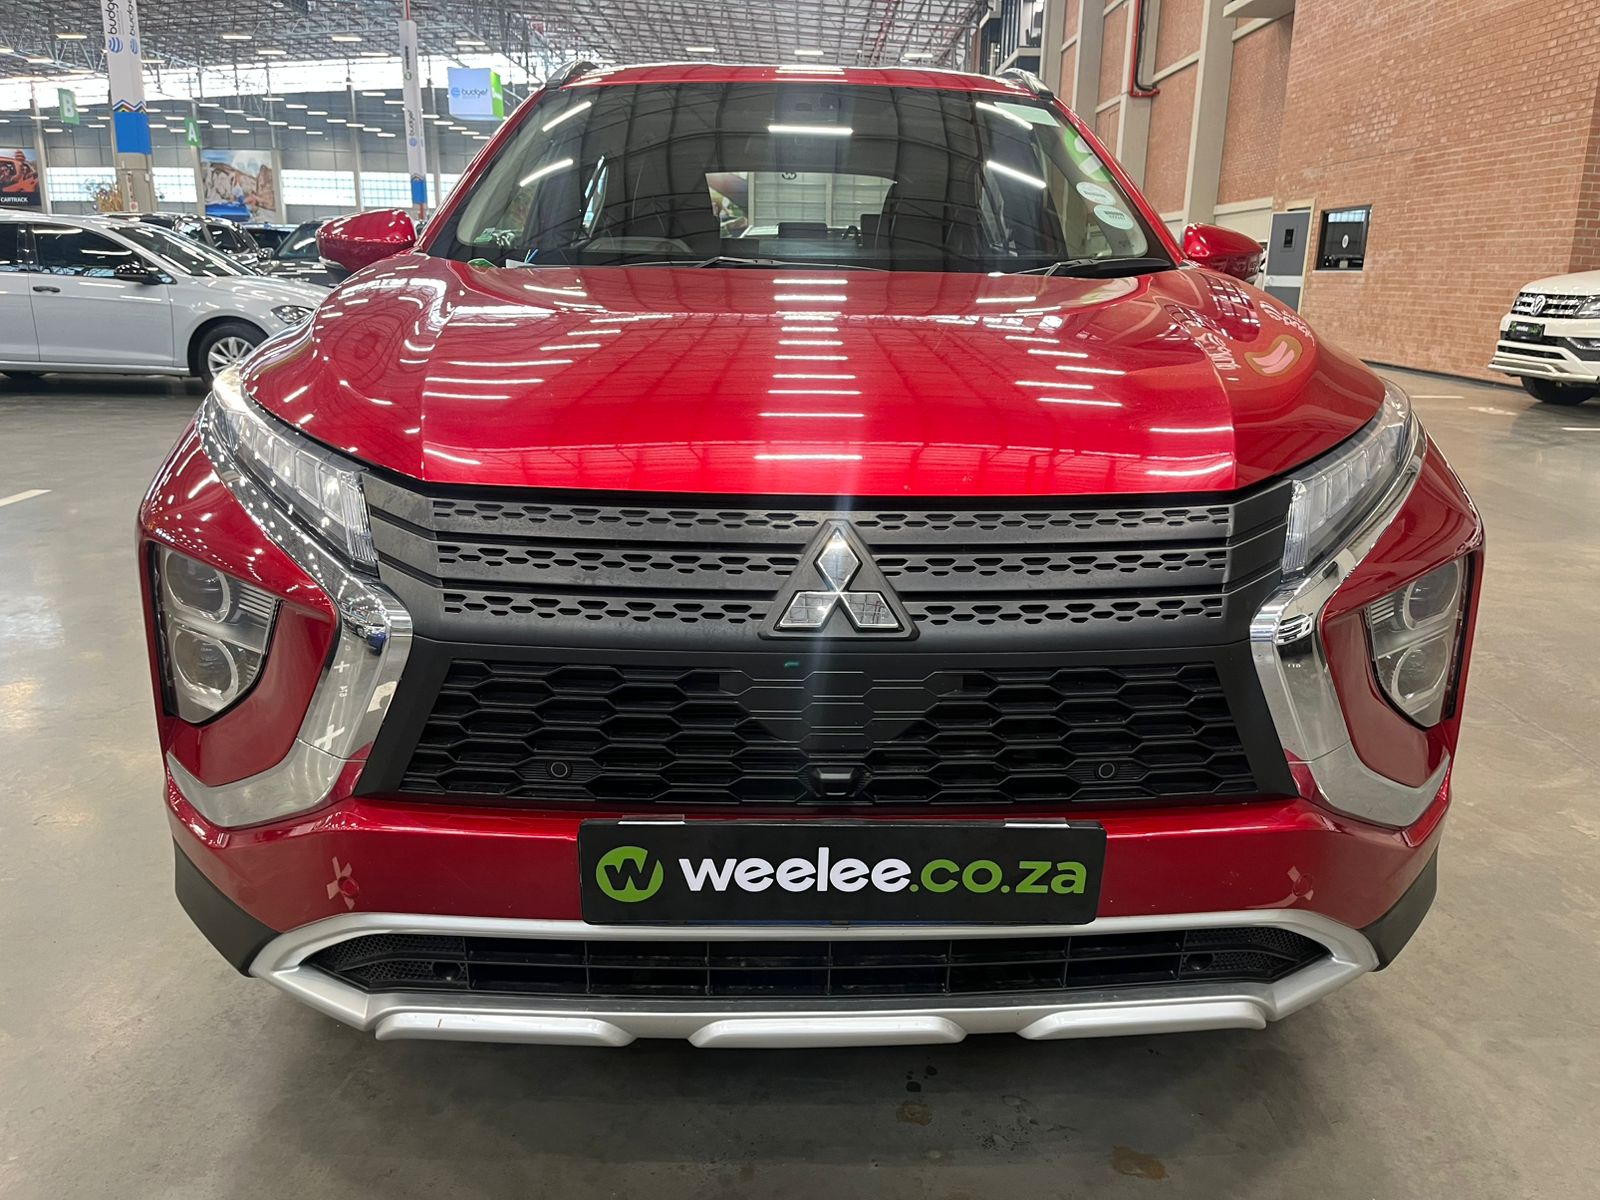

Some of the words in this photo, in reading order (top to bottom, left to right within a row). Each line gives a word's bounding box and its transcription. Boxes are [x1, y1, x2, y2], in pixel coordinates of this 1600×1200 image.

[461, 87, 488, 99] budget
[63, 94, 75, 118] B
[188, 121, 198, 142] A
[678, 846, 1087, 895] weelee.co.za
